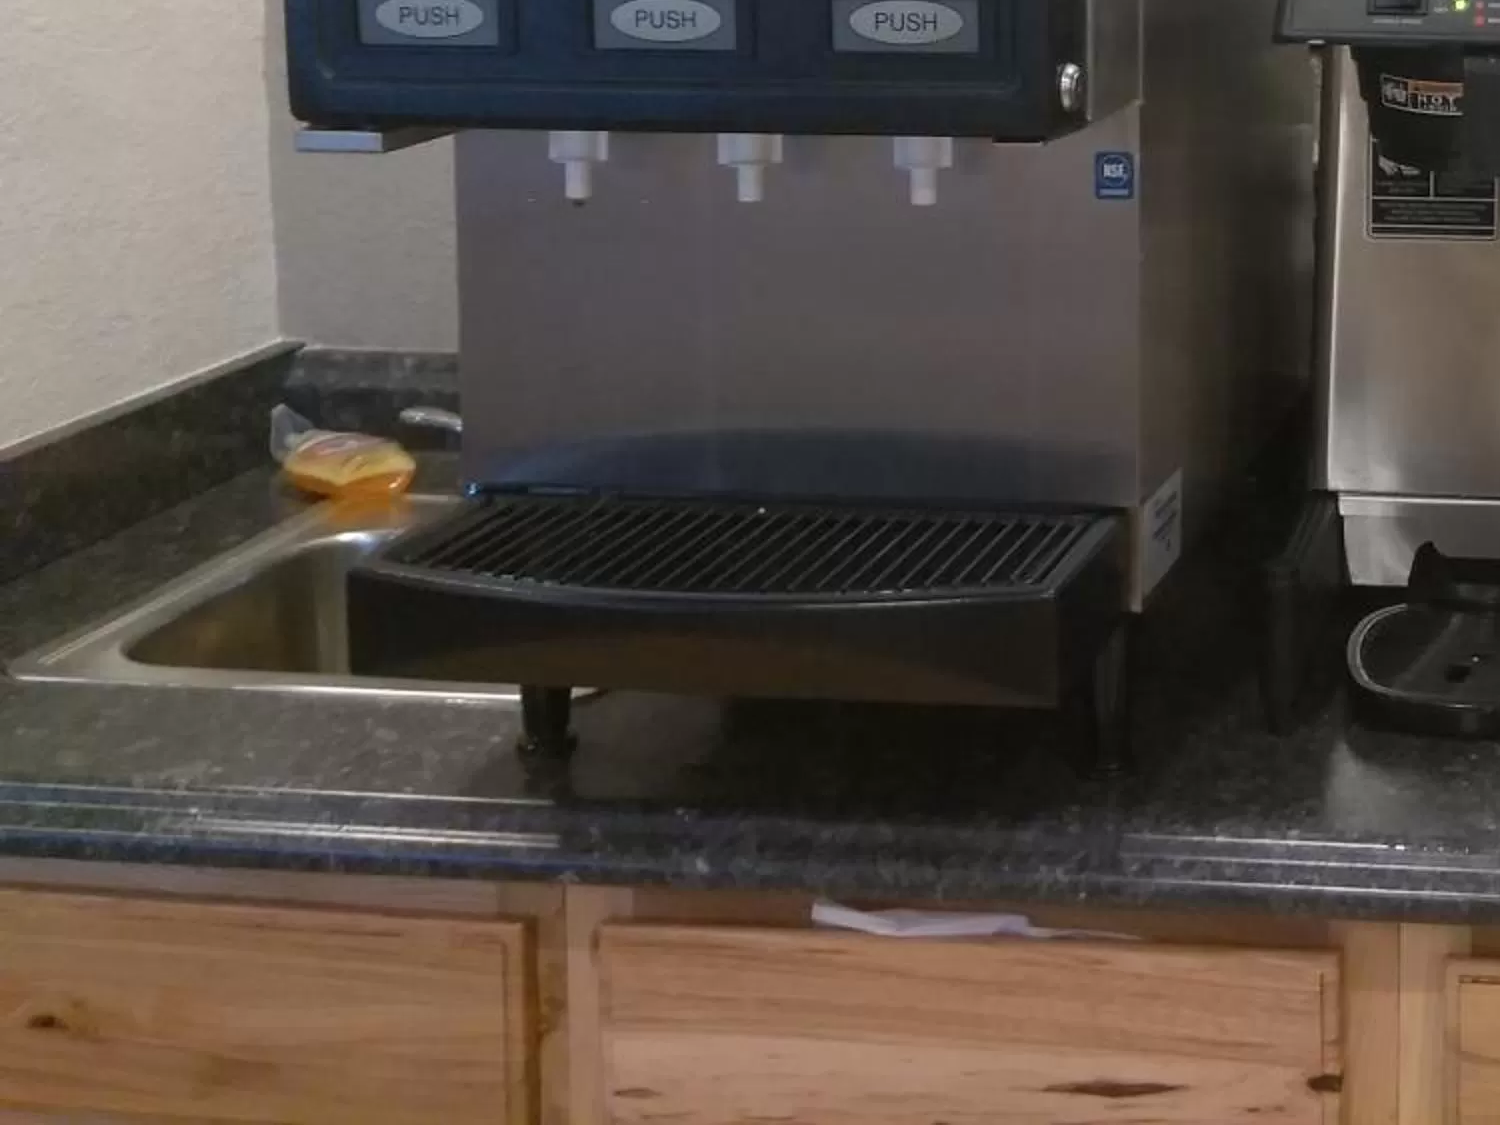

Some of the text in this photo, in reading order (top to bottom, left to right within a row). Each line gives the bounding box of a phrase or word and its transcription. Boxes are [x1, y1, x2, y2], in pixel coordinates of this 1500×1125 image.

[399, 6, 460, 26] PUSH
[635, 10, 697, 29] PUSH
[874, 12, 938, 32] PUSH
